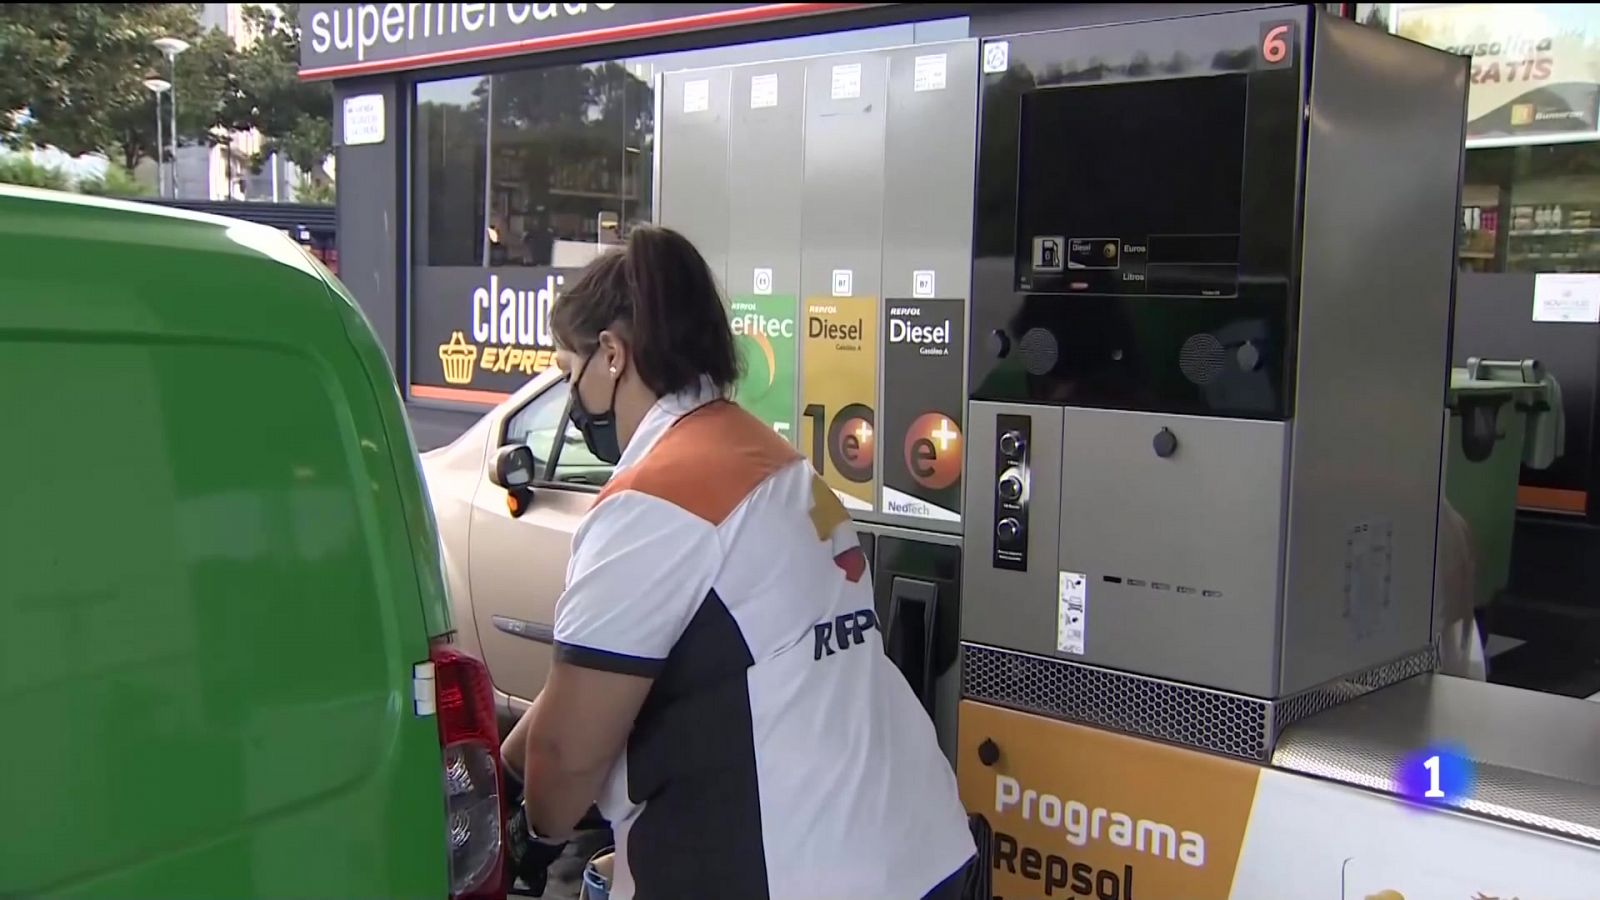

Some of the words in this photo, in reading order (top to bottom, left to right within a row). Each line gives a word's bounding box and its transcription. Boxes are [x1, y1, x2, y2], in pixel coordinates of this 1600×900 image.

[311, 3, 616, 61] supermerc
[1263, 25, 1289, 63] 6
[1123, 244, 1146, 253] Euros
[1122, 272, 1145, 281] Litros
[890, 307, 921, 316] REPSOL
[731, 313, 794, 338] efitec
[808, 316, 863, 341] Diesel
[889, 318, 950, 344] Diesel
[994, 774, 1205, 867] Programa
[993, 831, 1134, 900] Repsol
